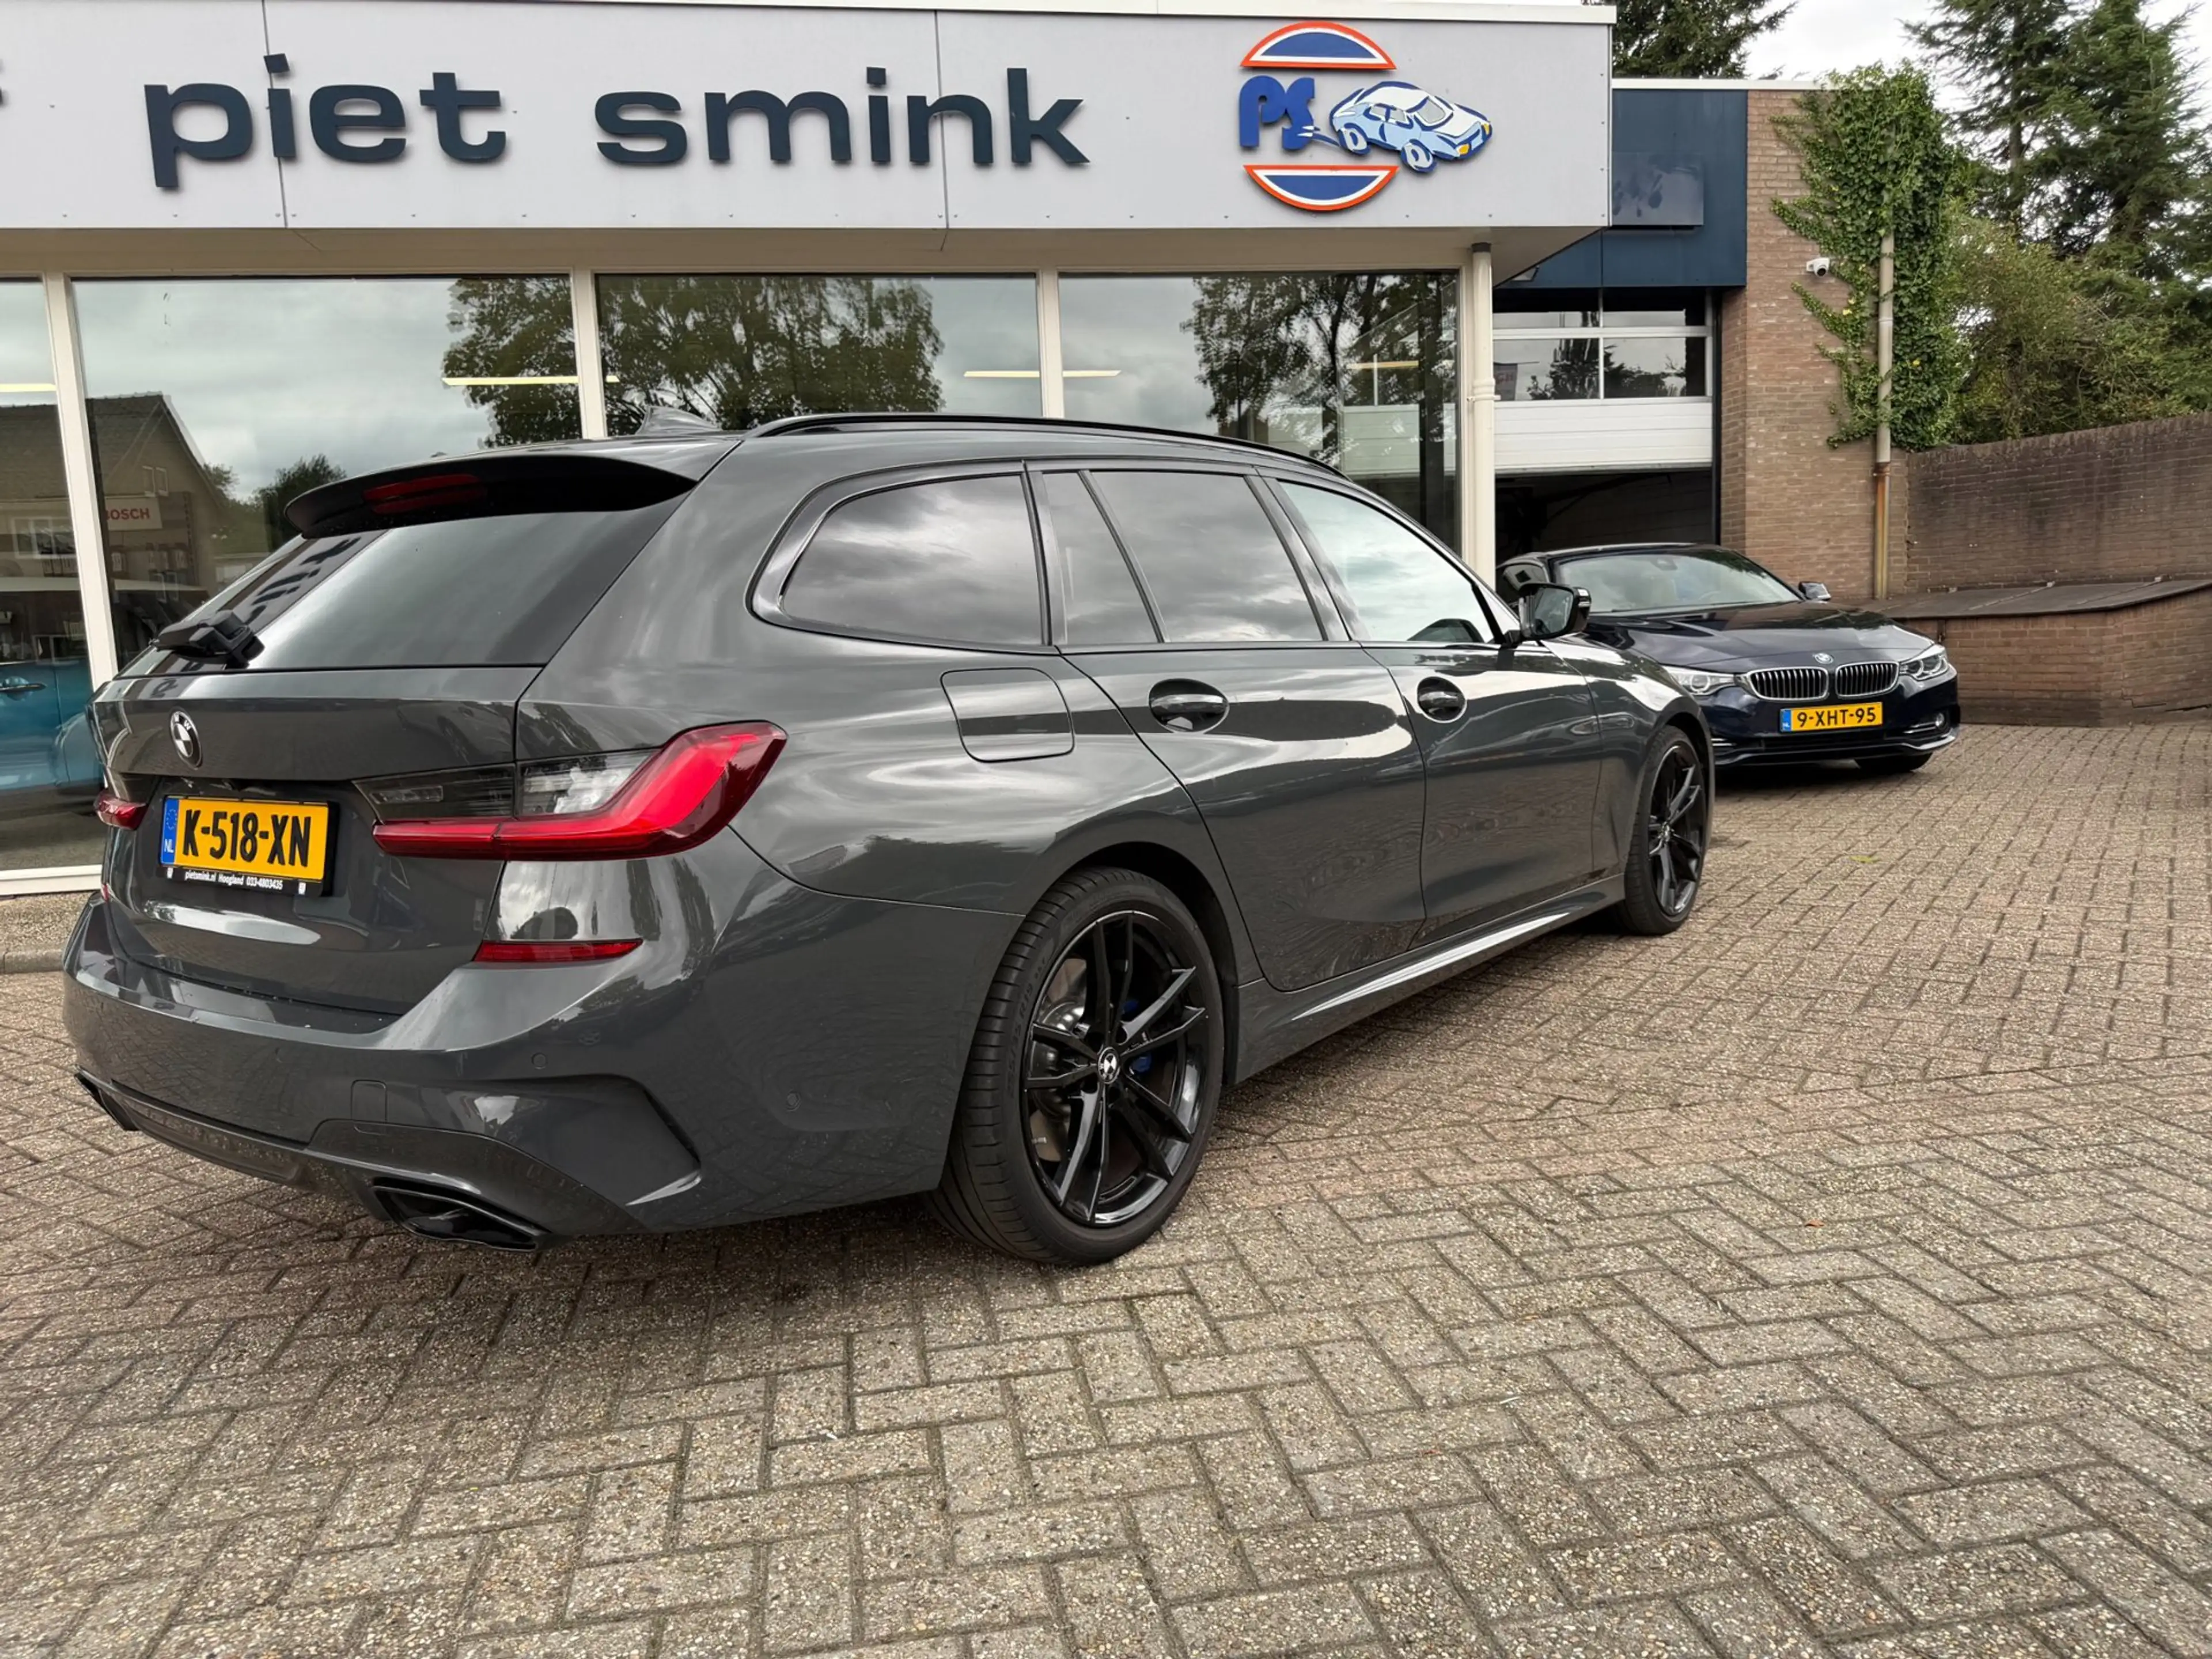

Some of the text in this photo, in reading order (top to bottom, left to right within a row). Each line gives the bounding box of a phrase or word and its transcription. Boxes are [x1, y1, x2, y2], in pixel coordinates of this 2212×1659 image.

[144, 53, 1090, 188] piet smink
[1797, 707, 1876, 728] 9-XHT-95
[164, 838, 174, 853] NL
[182, 809, 312, 868] K-518-XN
[184, 870, 217, 882] pietsmink.nl
[218, 873, 244, 886] Hoogland
